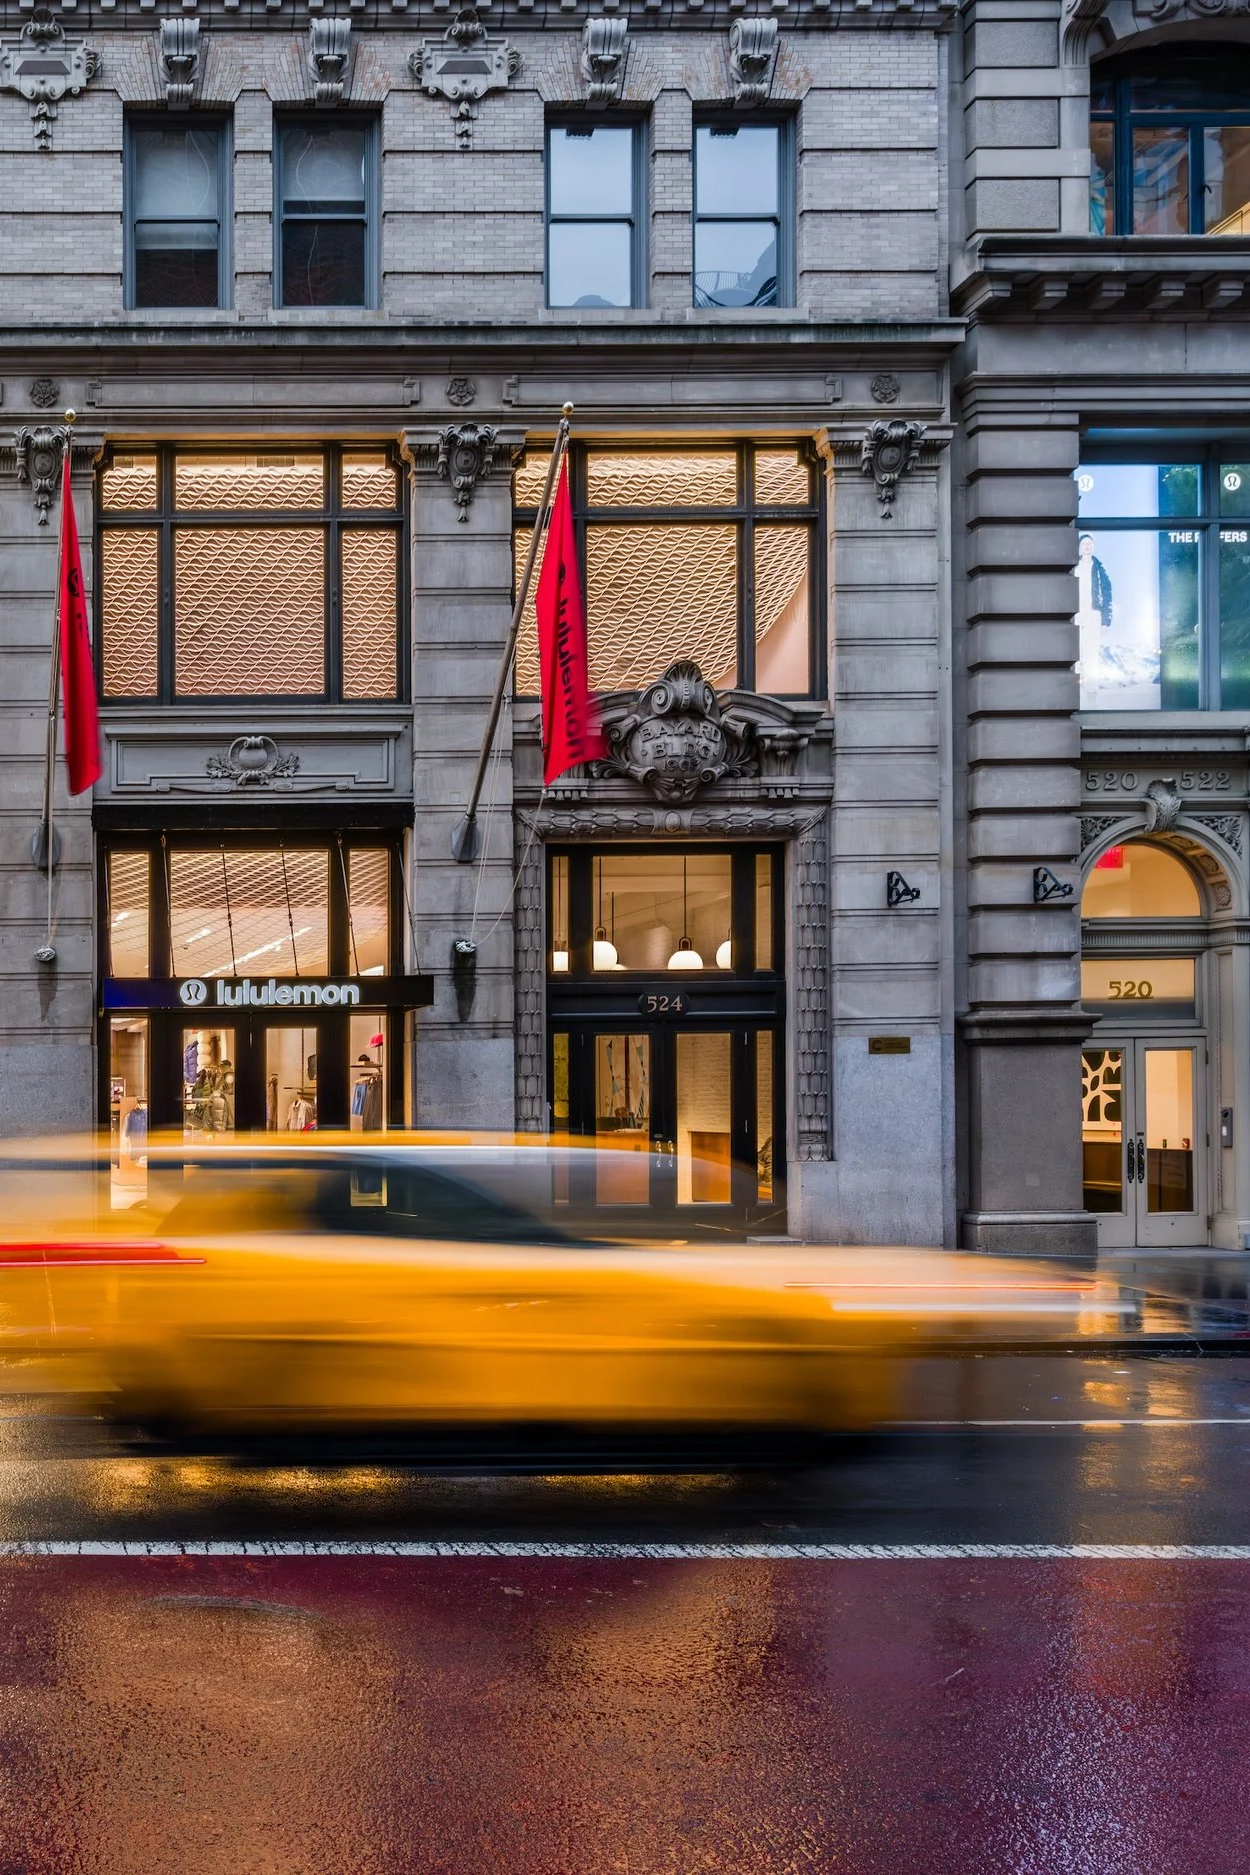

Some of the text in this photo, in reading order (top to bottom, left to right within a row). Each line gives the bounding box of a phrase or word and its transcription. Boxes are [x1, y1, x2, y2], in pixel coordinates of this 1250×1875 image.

[1168, 531, 1193, 543] THE
[639, 720, 722, 743] BAYARD
[653, 742, 711, 759] BLDG
[1085, 770, 1231, 791] 520 522
[216, 978, 360, 1006] lululemon
[1109, 981, 1152, 998] 520
[647, 995, 683, 1013] 524
